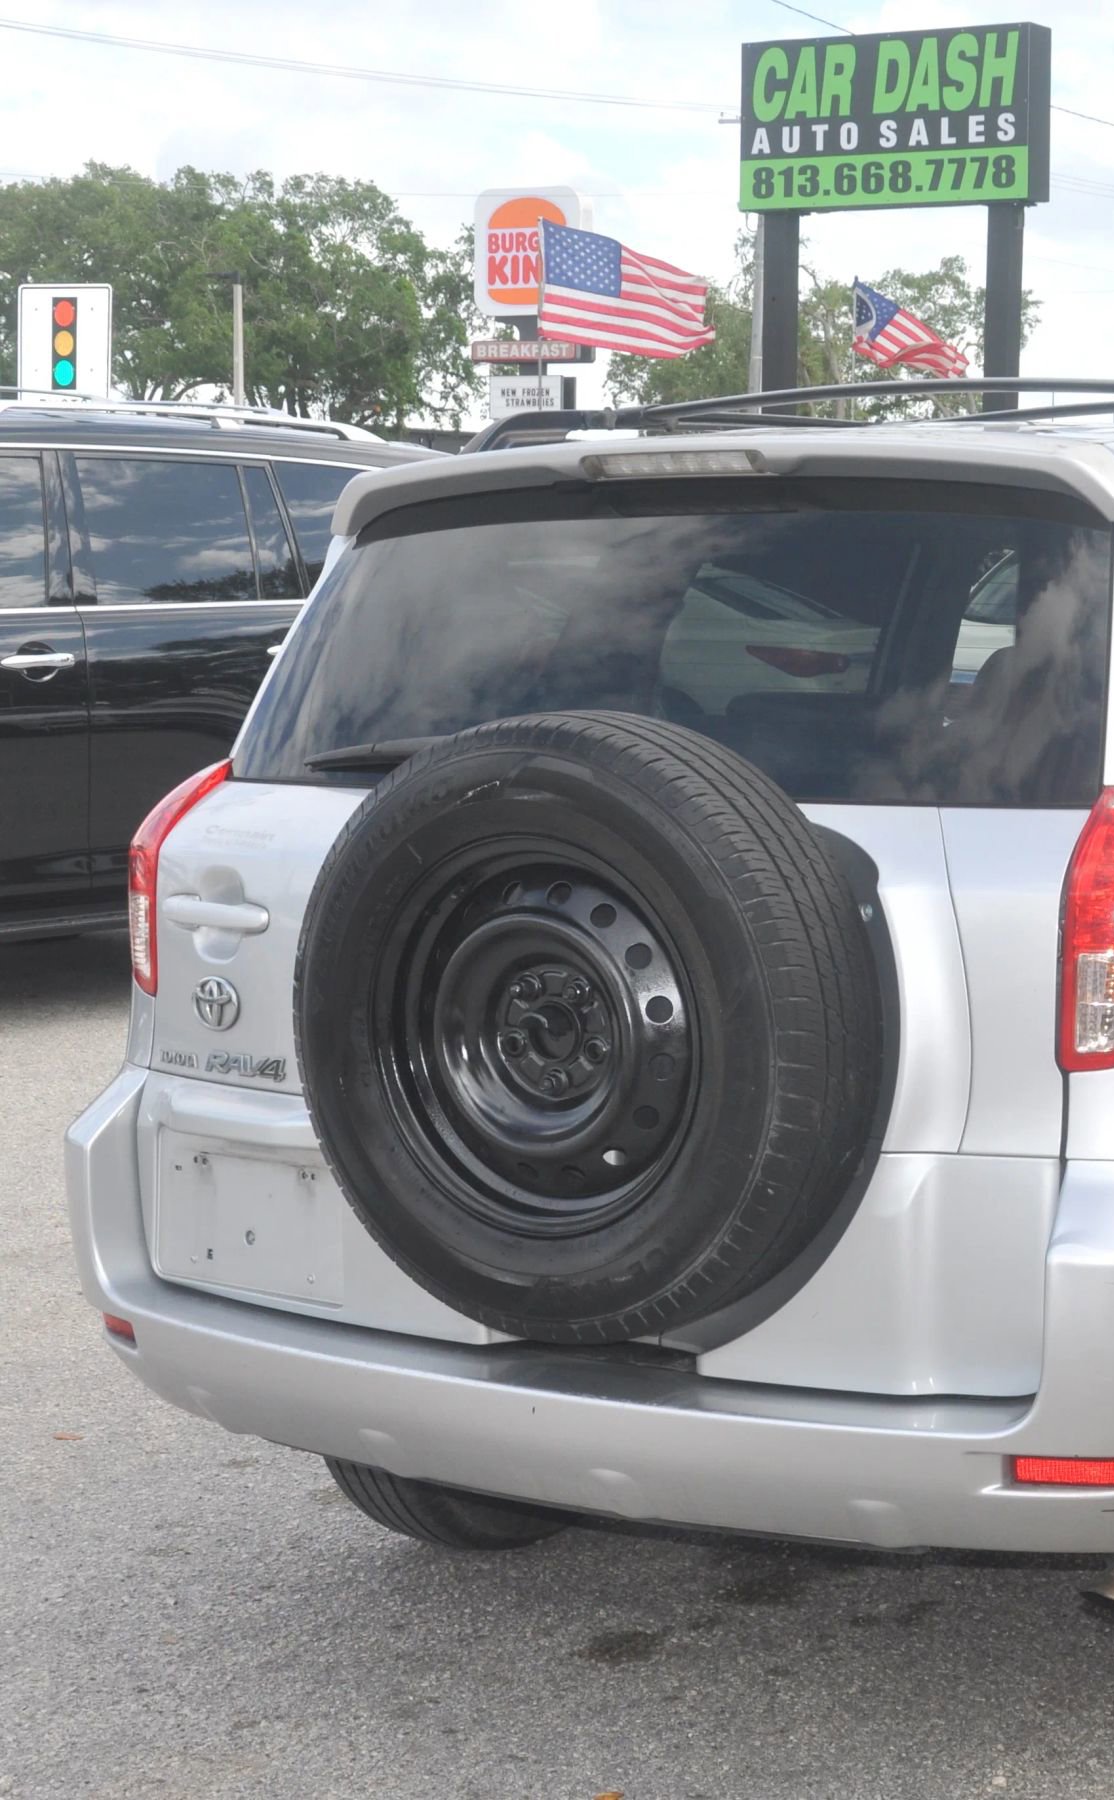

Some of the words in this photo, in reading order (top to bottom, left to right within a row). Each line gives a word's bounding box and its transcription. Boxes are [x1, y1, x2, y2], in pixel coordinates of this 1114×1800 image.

[752, 42, 857, 123] CAR
[872, 30, 1020, 115] DASH
[751, 121, 859, 154] AUTO
[879, 112, 1016, 148] SALES
[751, 154, 1017, 199] 813.668.7778
[488, 231, 539, 254] BURG
[488, 254, 543, 285] KIN
[476, 343, 570, 358] BREAKFAST
[500, 387, 517, 397] NEW
[204, 1048, 287, 1083] RAV4
